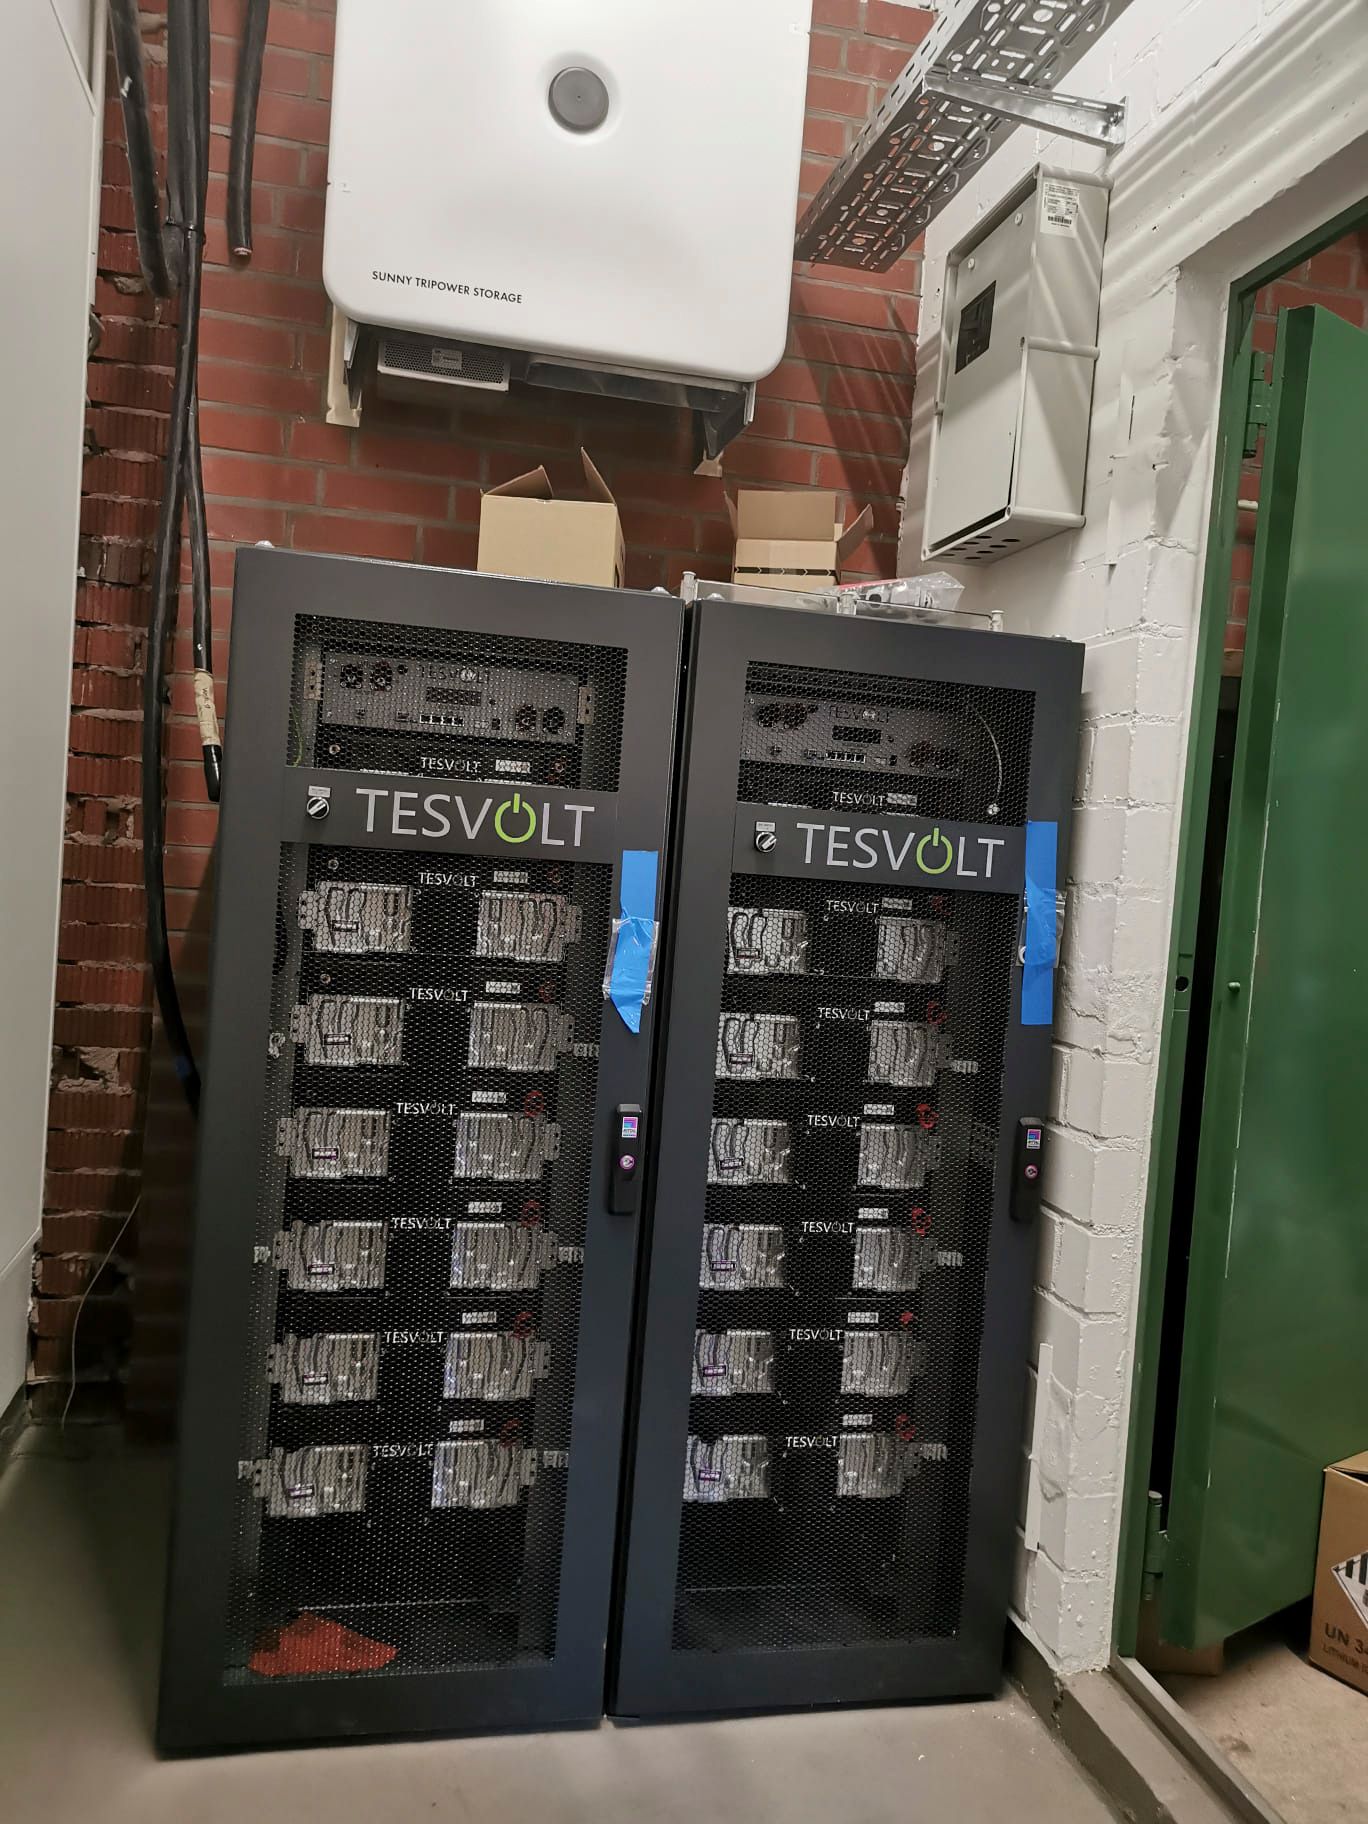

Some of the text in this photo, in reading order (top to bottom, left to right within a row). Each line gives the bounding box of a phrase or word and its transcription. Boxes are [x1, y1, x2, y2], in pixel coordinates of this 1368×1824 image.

[372, 270, 523, 304] SUNNY TRIPOWER STORAGE
[420, 756, 481, 773] TESVOLT
[833, 791, 886, 807] TESVOLT
[356, 787, 595, 847] TESVOLT
[796, 822, 1005, 878] TESVOLT
[418, 871, 479, 888] TESVOLT
[826, 899, 879, 914] TESVOLT
[409, 987, 469, 1002] TESVOLT
[818, 1007, 870, 1021] TESVOLT
[396, 1102, 455, 1116] TESVOLT
[807, 1114, 860, 1128] TESVOLT
[391, 1217, 451, 1230] TESVOLT
[801, 1221, 854, 1233] TESVOLT
[384, 1330, 445, 1344] TESVOLT
[789, 1328, 843, 1341] TESVOLT
[785, 1435, 837, 1448] TESVOLT
[372, 1442, 434, 1458] TESVOLT
[1325, 1622, 1368, 1655] UN 3
